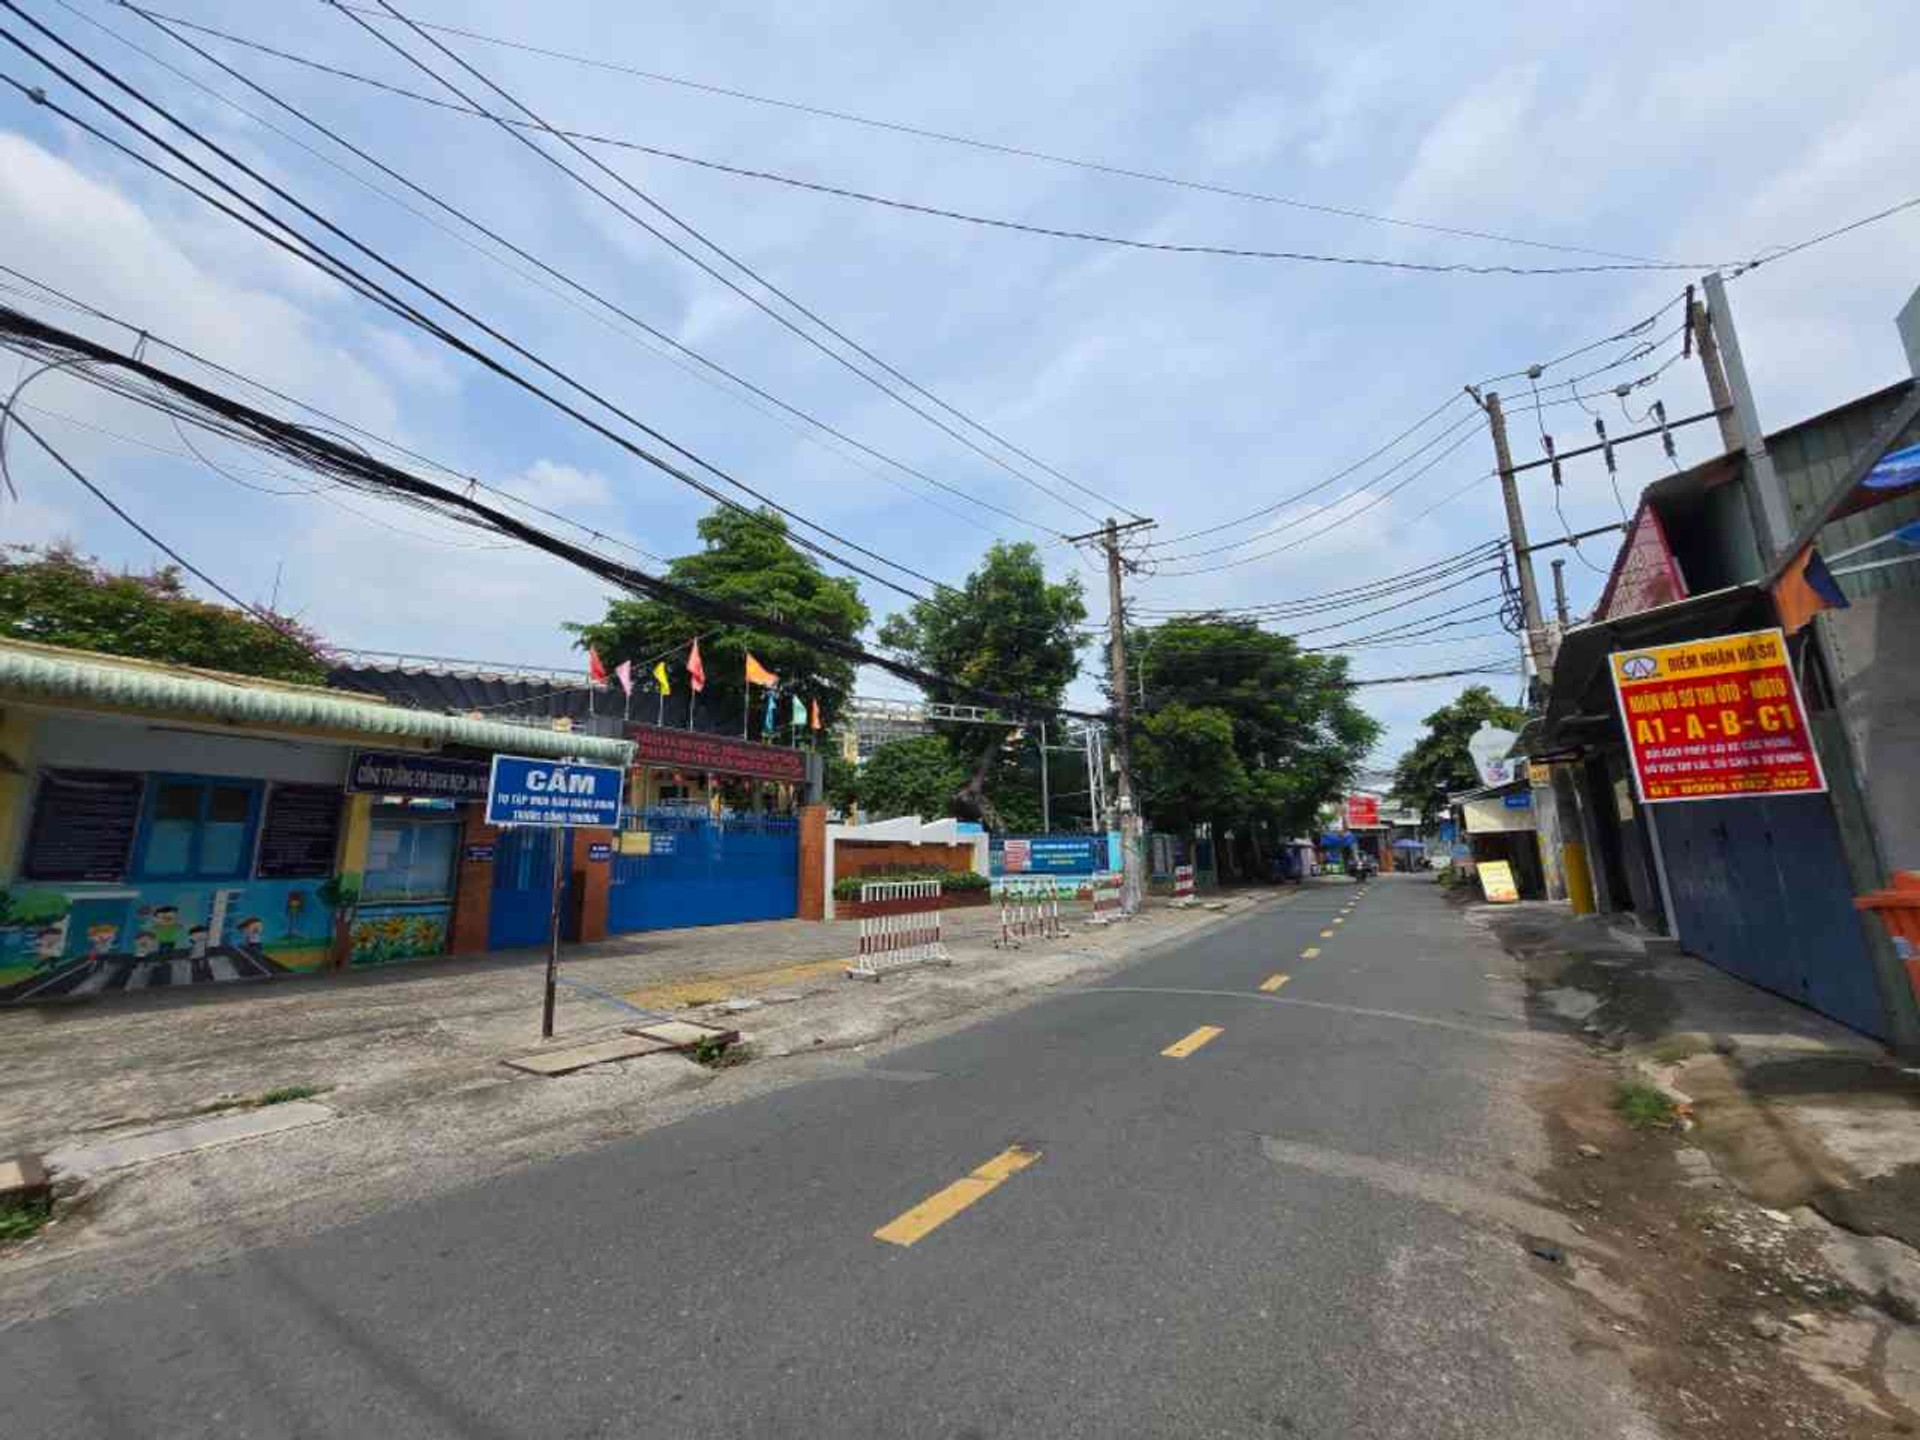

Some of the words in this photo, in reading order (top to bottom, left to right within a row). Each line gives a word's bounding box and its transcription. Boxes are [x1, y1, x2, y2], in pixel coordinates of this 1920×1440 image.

[1636, 716, 1667, 745] A1
[1685, 713, 1705, 740] A
[1720, 709, 1742, 737] B
[1758, 703, 1796, 733] C1
[526, 766, 596, 795] CẤM
